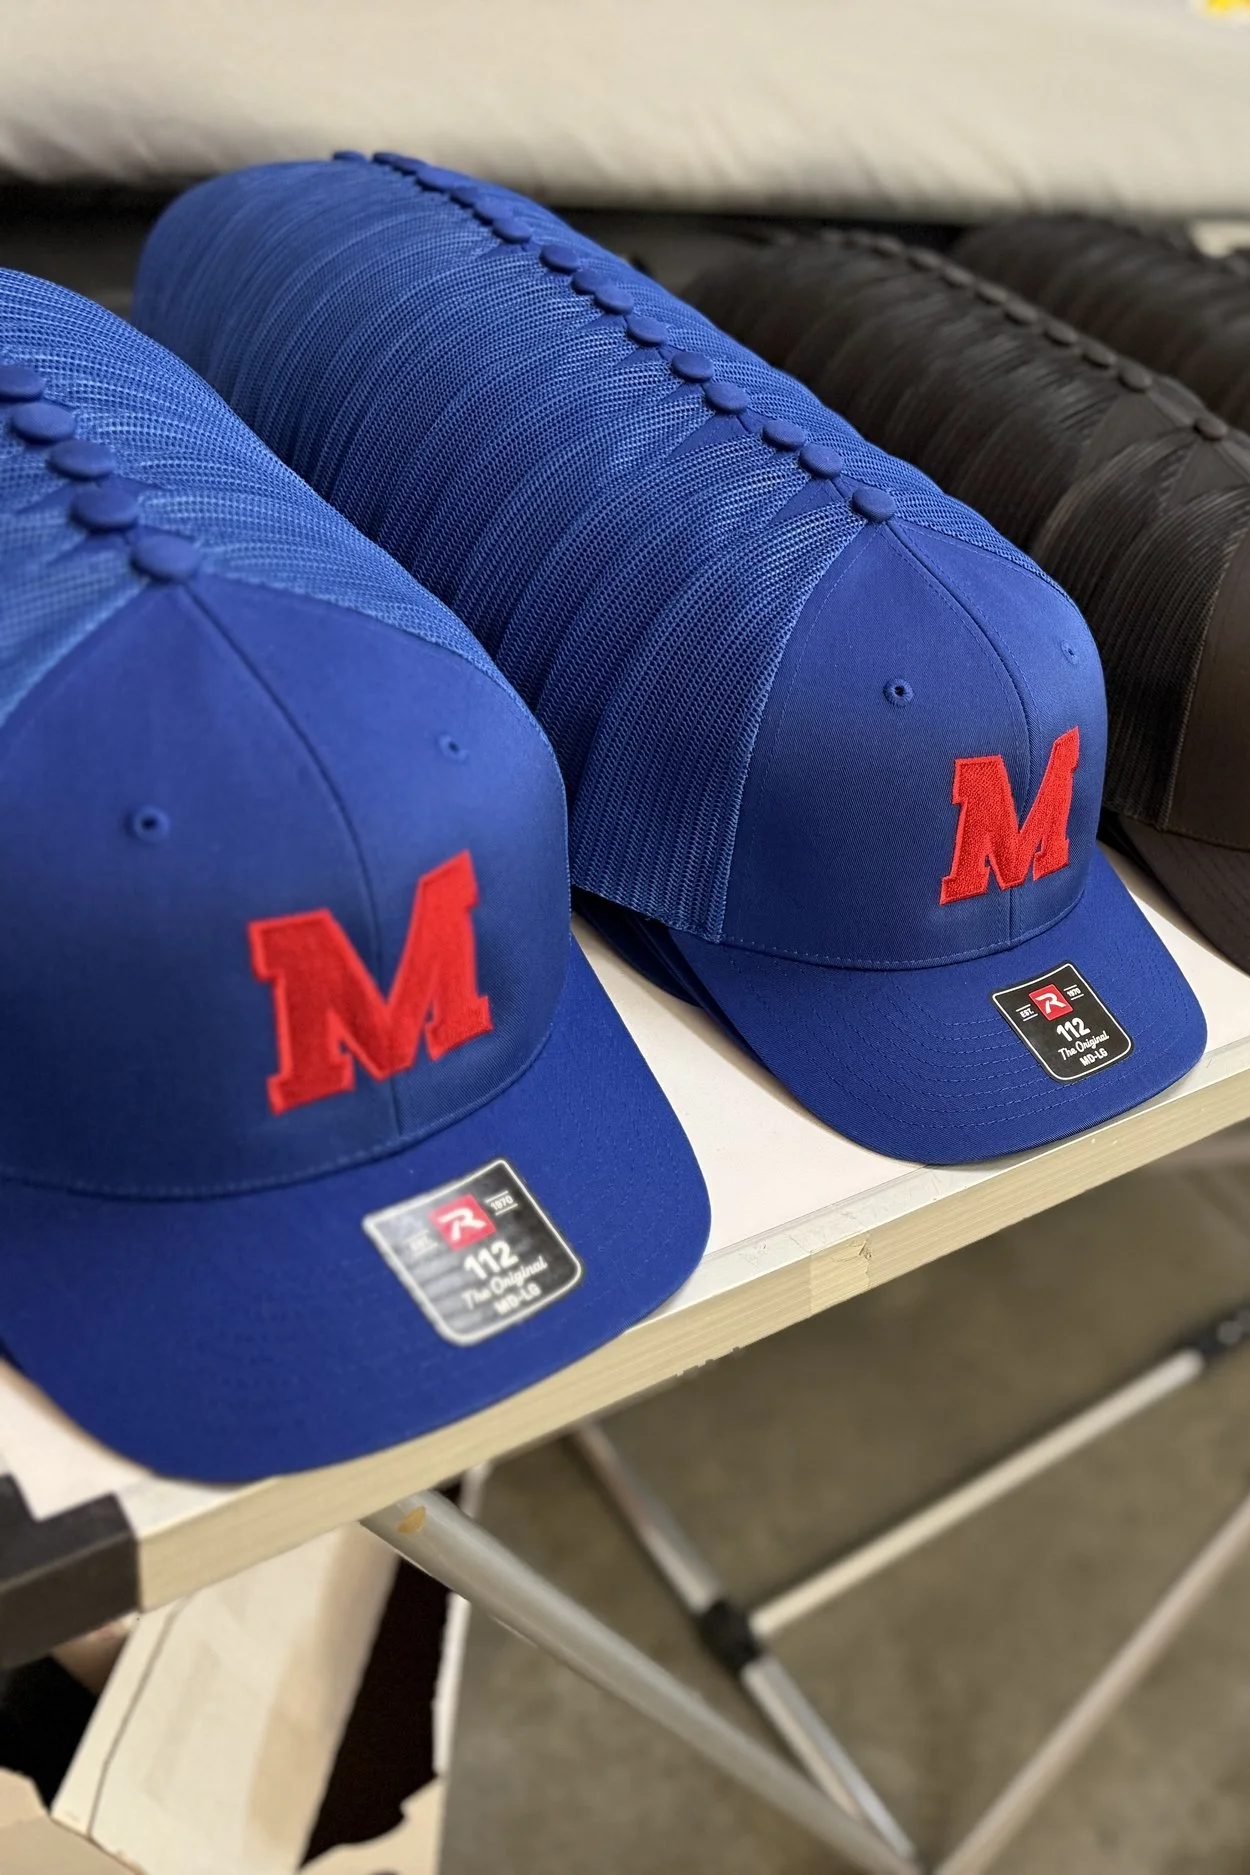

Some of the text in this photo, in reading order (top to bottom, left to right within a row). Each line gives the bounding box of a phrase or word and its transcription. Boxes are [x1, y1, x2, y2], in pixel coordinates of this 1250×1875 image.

[939, 727, 1080, 906] M
[247, 850, 494, 1117] M
[1056, 1017, 1091, 1042] 112
[1058, 1030, 1110, 1061] The Original
[1079, 1049, 1108, 1067] MD-LG
[490, 1195, 514, 1211] 1970
[463, 1242, 520, 1280] 112
[461, 1255, 549, 1310] The Original
[493, 1283, 542, 1315] MD-LG
